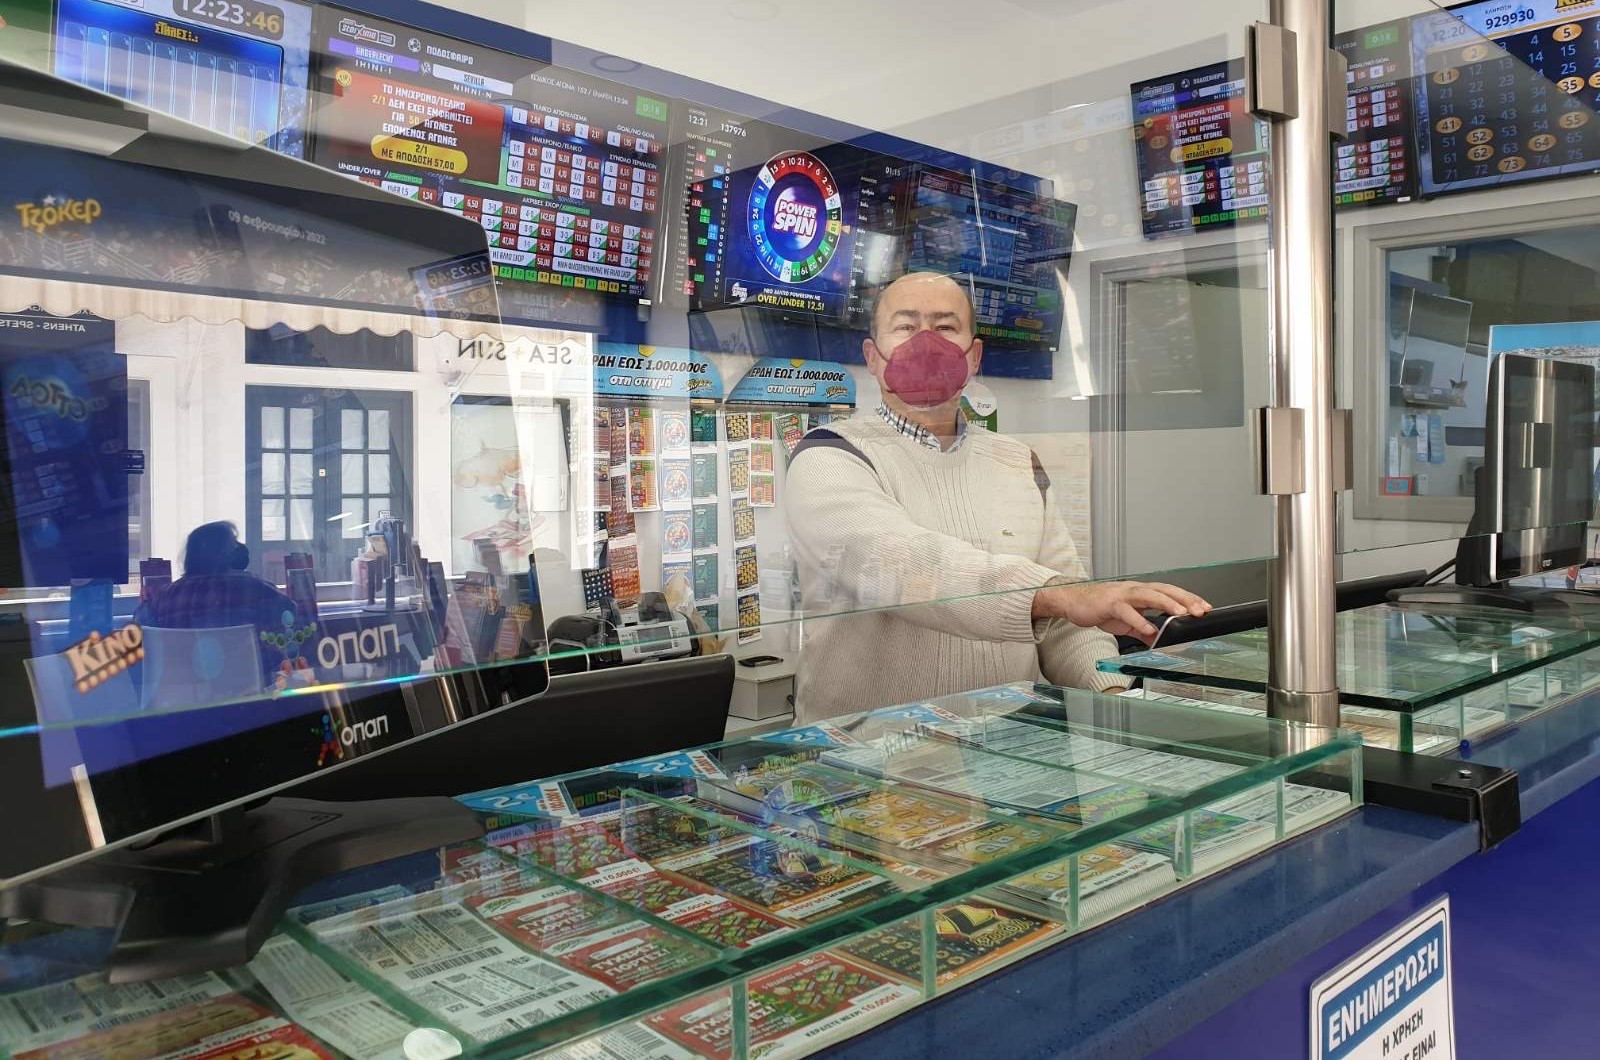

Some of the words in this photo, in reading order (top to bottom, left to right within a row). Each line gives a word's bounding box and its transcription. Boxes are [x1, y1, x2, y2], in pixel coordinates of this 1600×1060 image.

[1485, 8, 1535, 30] 929930
[1530, 35, 1539, 45] 4
[1563, 27, 1571, 39] 5
[1439, 71, 1452, 81] 11
[1470, 65, 1482, 75] 12
[1528, 52, 1544, 63] 14
[1560, 45, 1576, 57] 15
[1440, 88, 1453, 98] 21
[1468, 82, 1484, 92] 22
[1499, 76, 1514, 86] 23
[1560, 63, 1577, 75] 25
[372, 94, 386, 105] 2/1
[1440, 104, 1454, 115] 31
[1469, 99, 1485, 109] 32
[1500, 92, 1515, 104] 33
[1562, 79, 1578, 90] 35
[688, 114, 708, 127] 12:21
[1441, 120, 1456, 131] 41
[1471, 115, 1486, 126] 42
[1501, 109, 1516, 120] 43
[1531, 102, 1547, 114] 44
[720, 123, 747, 138] 137976
[1442, 138, 1456, 148] 51
[1472, 131, 1487, 142] 52
[1502, 126, 1517, 137] 53
[1534, 120, 1548, 131] 54
[1565, 114, 1582, 127] 55
[415, 144, 428, 154] 2/1
[1442, 152, 1457, 163] 61
[1473, 147, 1488, 158] 62
[1503, 142, 1518, 153] 63
[1534, 137, 1550, 148] 64
[1566, 132, 1583, 144] 65
[381, 148, 393, 159] ΜΕ
[396, 151, 433, 166] ΑΠΟΔΟΣΗ
[434, 158, 455, 170] 57,00
[788, 157, 796, 166] 10
[798, 157, 805, 167] 21
[1472, 164, 1488, 175] 72
[1503, 160, 1520, 171] 73
[1535, 154, 1551, 165] 74
[770, 164, 779, 175] 15
[826, 185, 834, 195] 20
[752, 208, 760, 219] 24
[778, 199, 817, 219] POWER
[774, 212, 818, 238] SPIN
[757, 293, 805, 309] OVER/UNDER
[617, 356, 645, 370] ΕΩΣ
[645, 359, 709, 374] 1.000.000€
[609, 374, 632, 387] στη
[633, 374, 672, 390] στιγμή
[774, 367, 795, 379] ΕΩΣ
[795, 369, 846, 382] 1.000.000€
[767, 384, 783, 394] στη
[786, 382, 817, 398] στιγμή
[1329, 937, 1439, 1053] ΕΝΗΜΕΡΩΣΗ
[1382, 1035, 1391, 1057] Η
[1392, 1008, 1424, 1050] ΧΡΗΣΗ
[1412, 1030, 1436, 1060] ΕΙΝΑΙ
